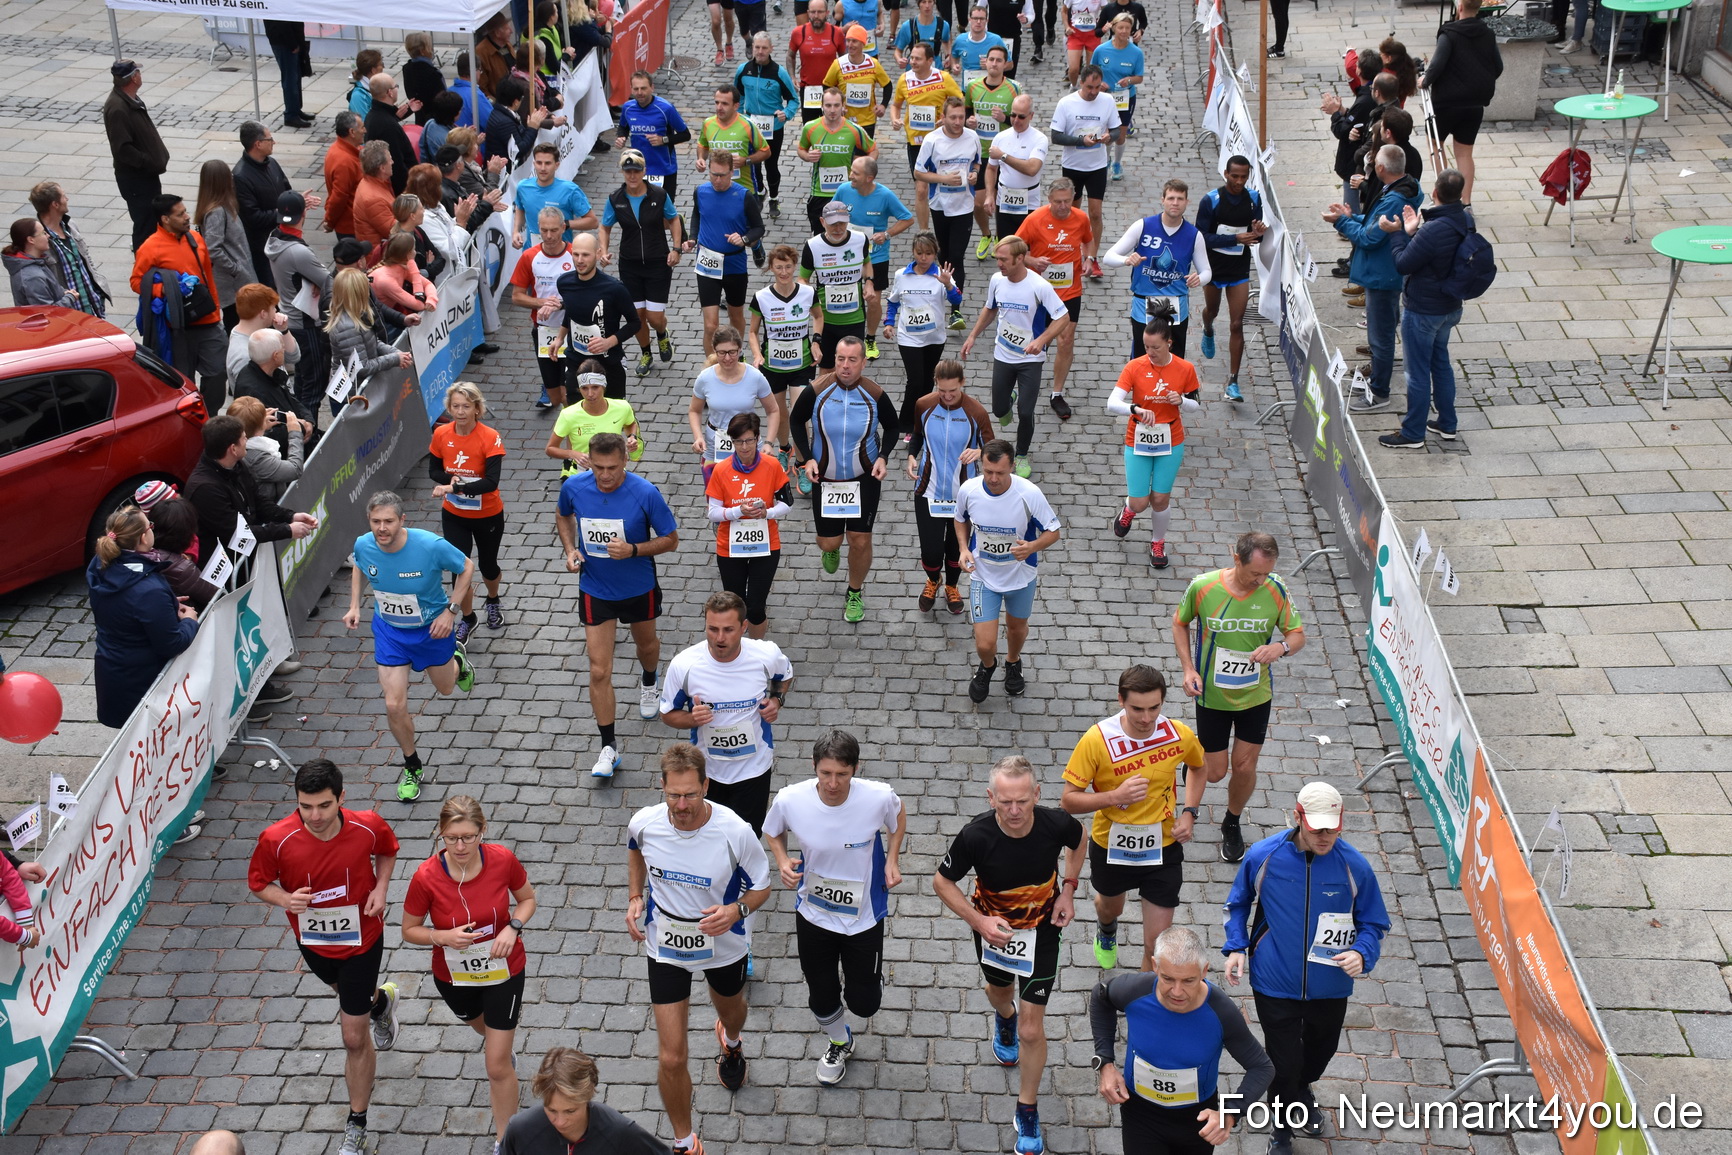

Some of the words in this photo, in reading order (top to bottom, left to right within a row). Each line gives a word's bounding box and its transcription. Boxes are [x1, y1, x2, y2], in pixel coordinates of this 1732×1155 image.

[240, 0, 268, 10] sein.
[849, 91, 867, 99] 2639
[907, 89, 925, 98] MAX
[925, 84, 945, 93] BÖGL
[912, 112, 932, 122] 2618
[977, 122, 996, 131] 2719
[823, 174, 844, 183] 2772
[1004, 194, 1024, 205] 2479
[1141, 234, 1163, 249] 33
[699, 255, 719, 268] 2585
[821, 268, 861, 278] Laufteam
[1048, 271, 1066, 279] 209
[830, 293, 854, 303] 2217
[908, 313, 931, 325] 2424
[769, 323, 808, 333] Laufteam
[1002, 329, 1026, 346] 2427
[773, 349, 798, 359] 2005
[720, 439, 733, 450] 29
[1140, 433, 1165, 444] 2031
[329, 453, 357, 495] OFFICE
[827, 492, 855, 504] 2702
[735, 530, 764, 543] 2489
[983, 541, 1013, 554] 2307
[211, 560, 226, 581] swn
[383, 601, 413, 615] 2715
[1206, 617, 1269, 633] BOCK
[1221, 660, 1256, 675] 2774
[710, 733, 748, 748] 2503
[1113, 758, 1146, 777] MAX
[1148, 745, 1184, 764] BÖGL
[12, 821, 30, 840] swn
[1116, 834, 1155, 849] 2616
[1123, 851, 1147, 859] Matthias
[666, 871, 709, 886] BÜSCHEL
[814, 885, 854, 905] 2306
[307, 918, 351, 932] 2112
[664, 931, 706, 949] 2008
[1322, 929, 1356, 946] 2415
[83, 914, 133, 998] Service-Line:
[1520, 952, 1530, 966] die
[1525, 932, 1547, 979] Neumarkts
[1544, 978, 1565, 1019] moderner
[1152, 1079, 1176, 1093] 88
